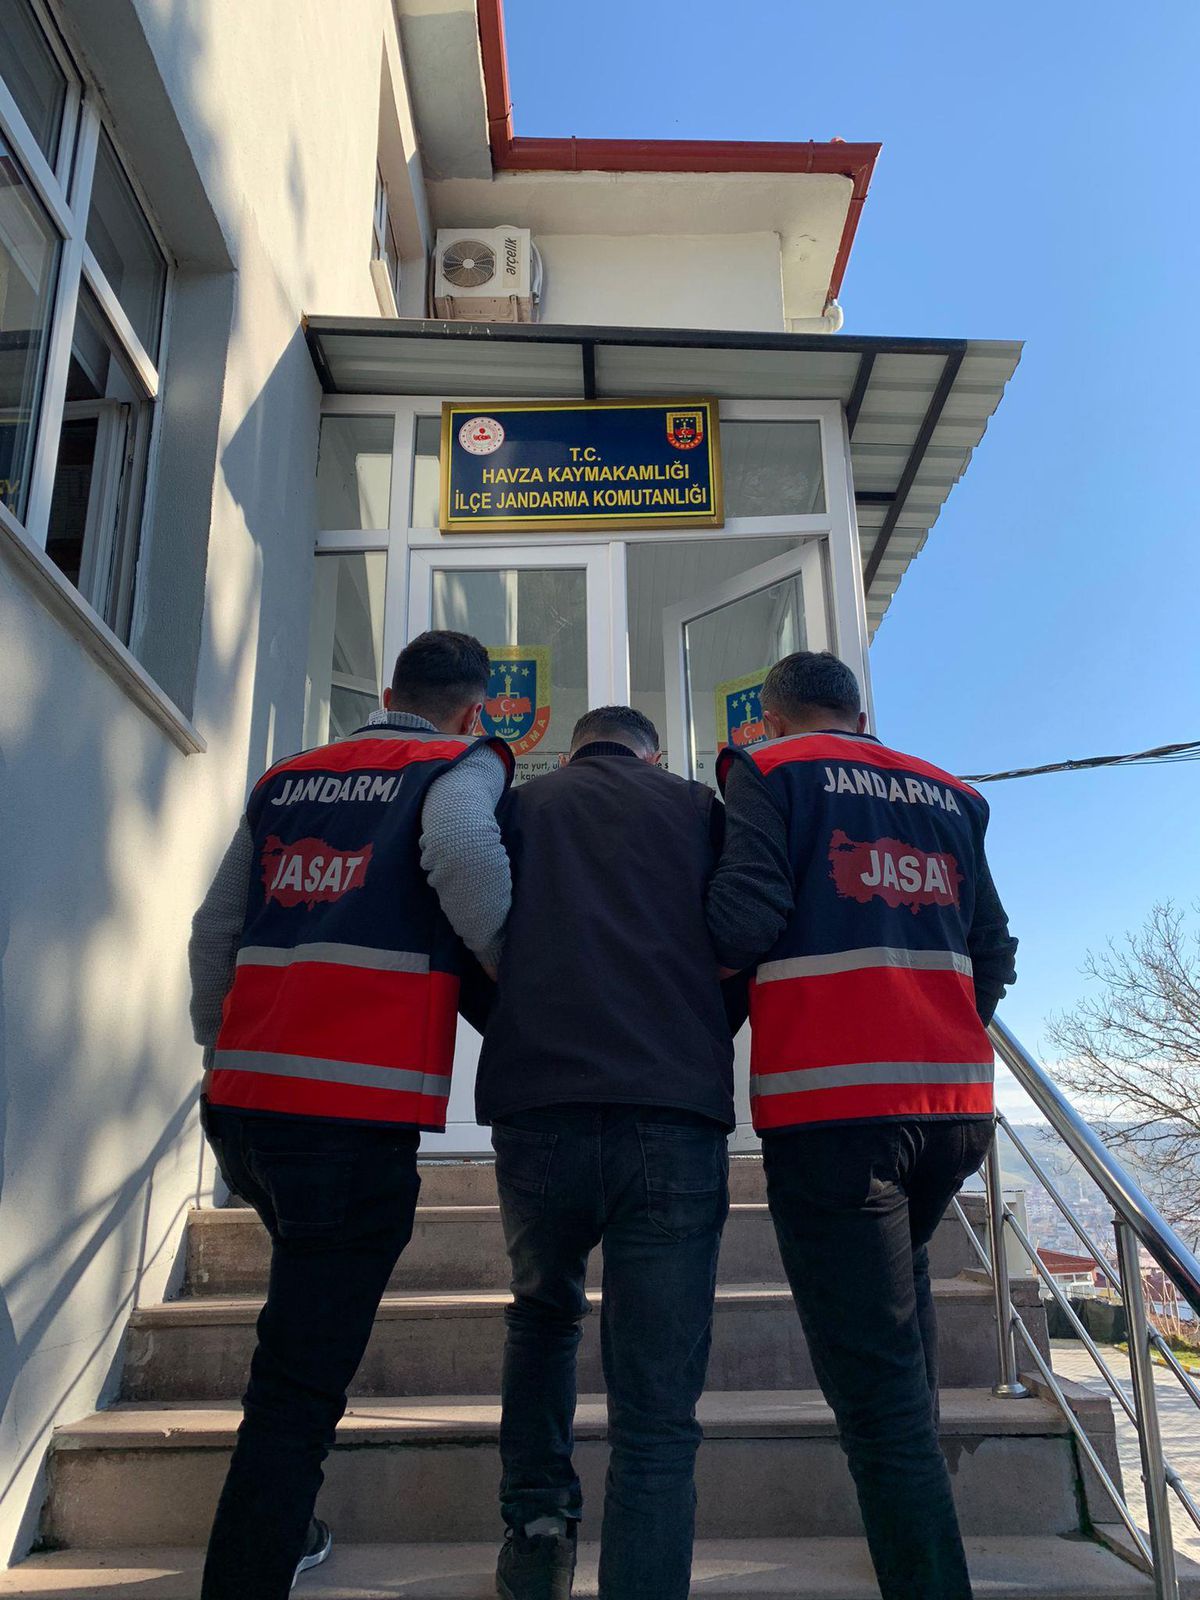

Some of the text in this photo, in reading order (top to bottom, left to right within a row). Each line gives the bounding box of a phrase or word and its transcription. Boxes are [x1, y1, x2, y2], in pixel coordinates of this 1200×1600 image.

[569, 447, 601, 462] T.C.
[482, 460, 689, 484] HAVZA KAYMAKAMLIĞI
[455, 483, 706, 513] İLÇE JANDARMA KOMUTANLIĞI
[823, 767, 962, 816] JANDARMA
